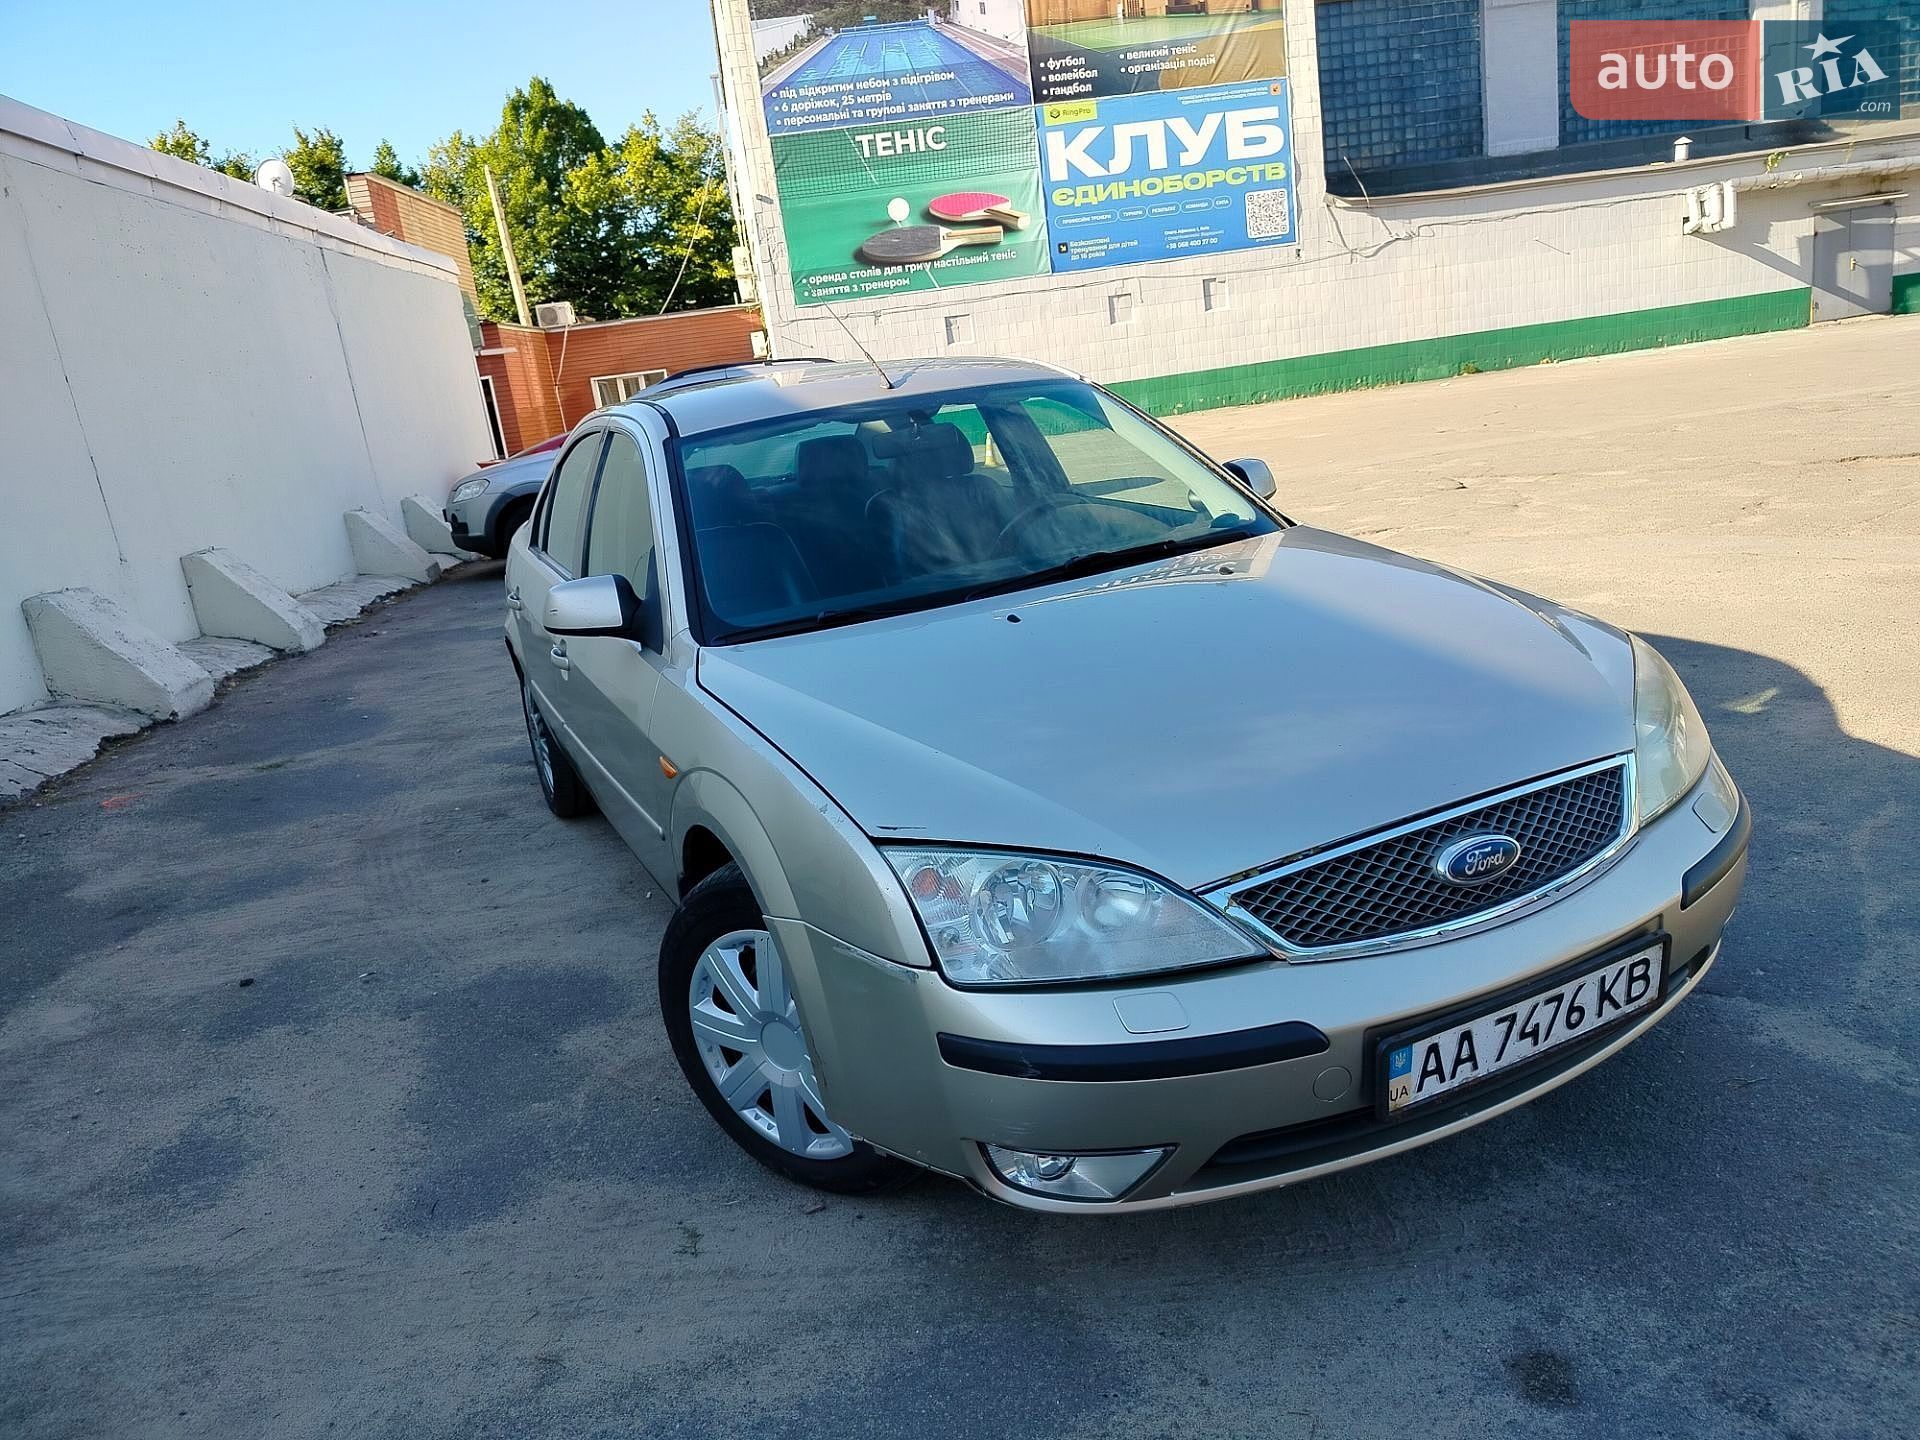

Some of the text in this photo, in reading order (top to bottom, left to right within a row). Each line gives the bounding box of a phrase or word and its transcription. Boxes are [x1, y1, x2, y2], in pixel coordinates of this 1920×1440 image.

[1047, 55, 1086, 70] футбол
[1126, 44, 1197, 60] великий теніс
[1049, 69, 1098, 83] волейбол
[1128, 55, 1216, 74] організація подій
[779, 71, 955, 99] під відкритим небом з підігрівом
[1050, 83, 1092, 96] гандбол
[781, 92, 892, 113] 6 доріжок, 25 метрів
[783, 92, 1015, 126] персональні та групові заняття з тренерами
[854, 125, 948, 158] ТЕНІС
[1045, 106, 1284, 182] КЛУБ
[1051, 162, 1287, 208] ЄДИНОБОРСТВ
[809, 272, 847, 285] оренда
[849, 267, 882, 279] столів
[883, 264, 903, 277] для
[904, 261, 923, 274] гри
[933, 251, 989, 269] настільний
[990, 250, 1017, 262] теніс
[811, 277, 910, 297] заняття з тренером
[1464, 846, 1505, 876] Ford
[1416, 957, 1651, 1093] AA 7476 KB
[1389, 1085, 1409, 1102] UA
